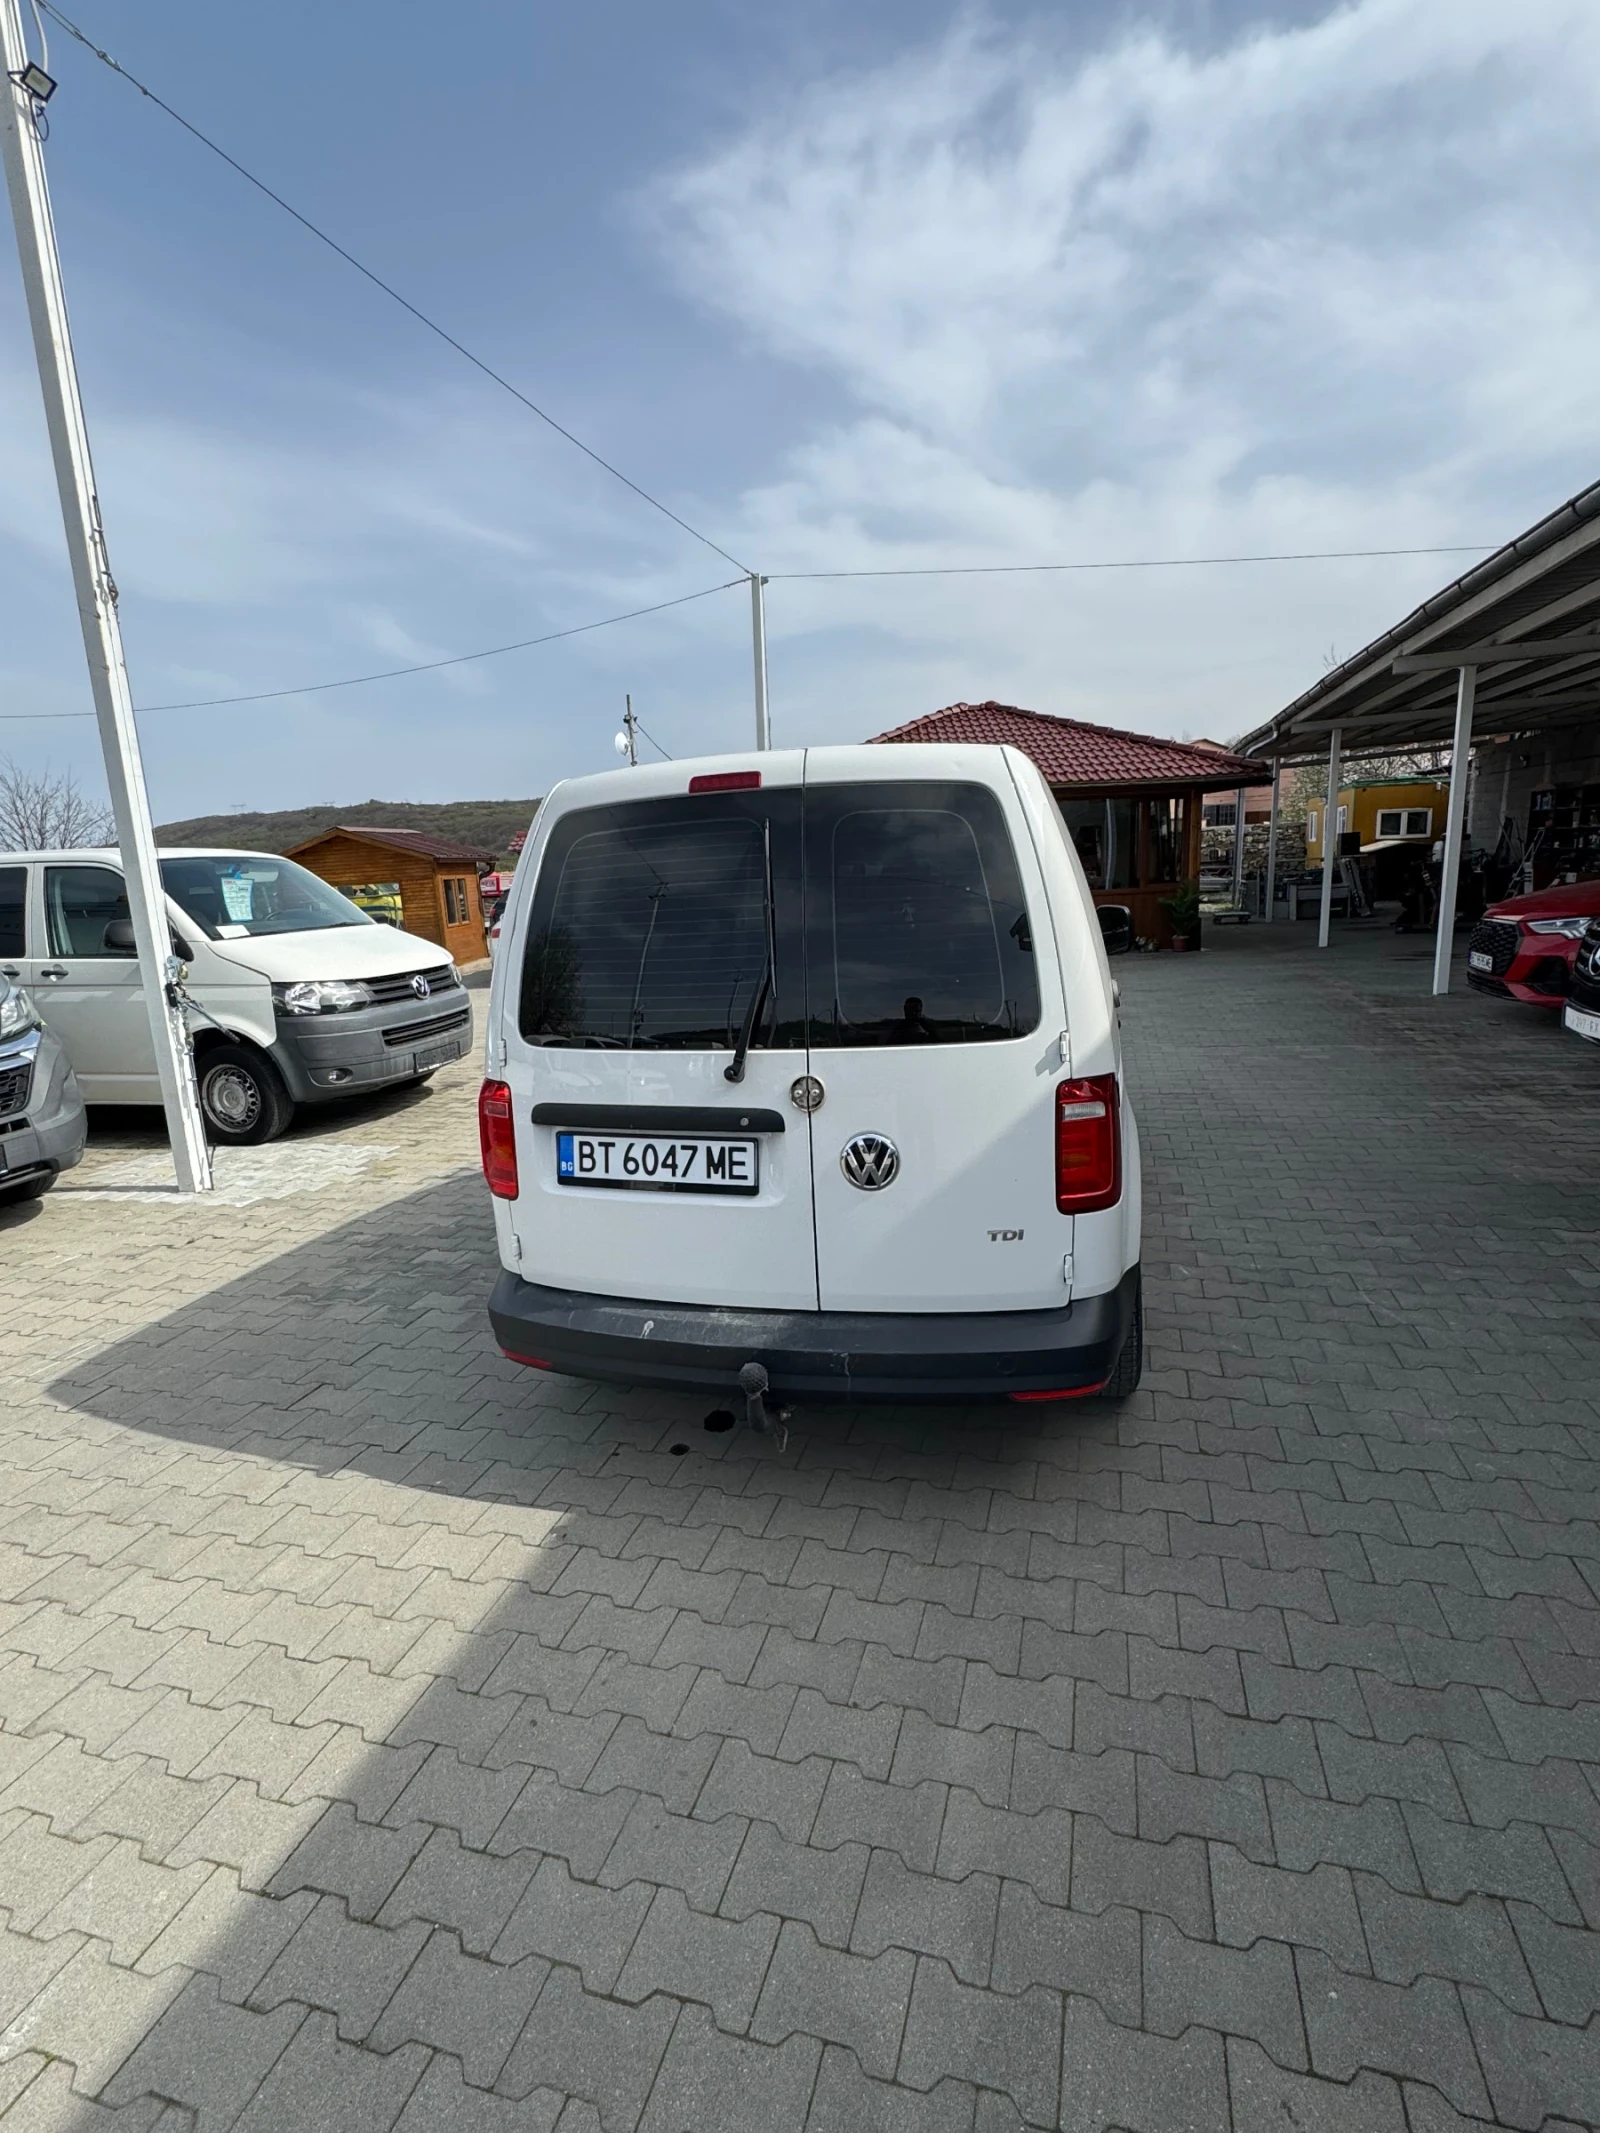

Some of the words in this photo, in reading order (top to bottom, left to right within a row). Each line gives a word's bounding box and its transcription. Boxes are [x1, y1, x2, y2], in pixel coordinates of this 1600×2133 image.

[561, 1161, 573, 1172] BG
[578, 1140, 616, 1174] BT
[623, 1142, 698, 1178] 6047
[706, 1145, 749, 1180] ME
[842, 1133, 898, 1189] VW
